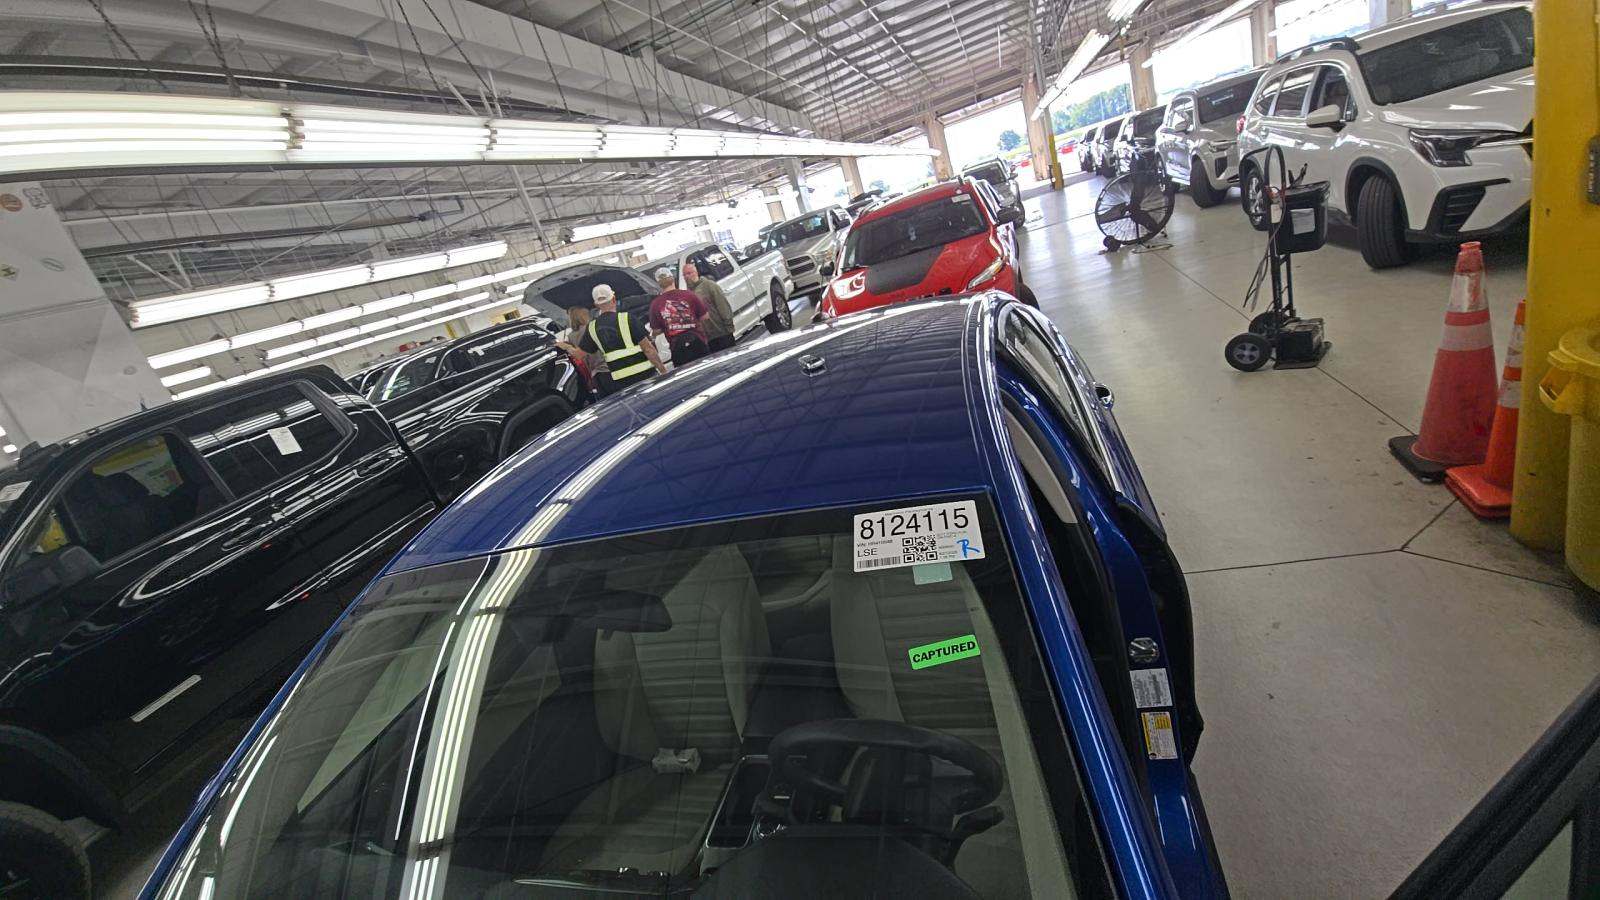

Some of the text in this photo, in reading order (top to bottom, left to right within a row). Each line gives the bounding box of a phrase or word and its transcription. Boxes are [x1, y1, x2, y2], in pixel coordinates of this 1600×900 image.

[860, 507, 969, 540] 8124115
[857, 548, 878, 558] LSE
[956, 539, 980, 559] R
[912, 641, 976, 663] CAPTURED
